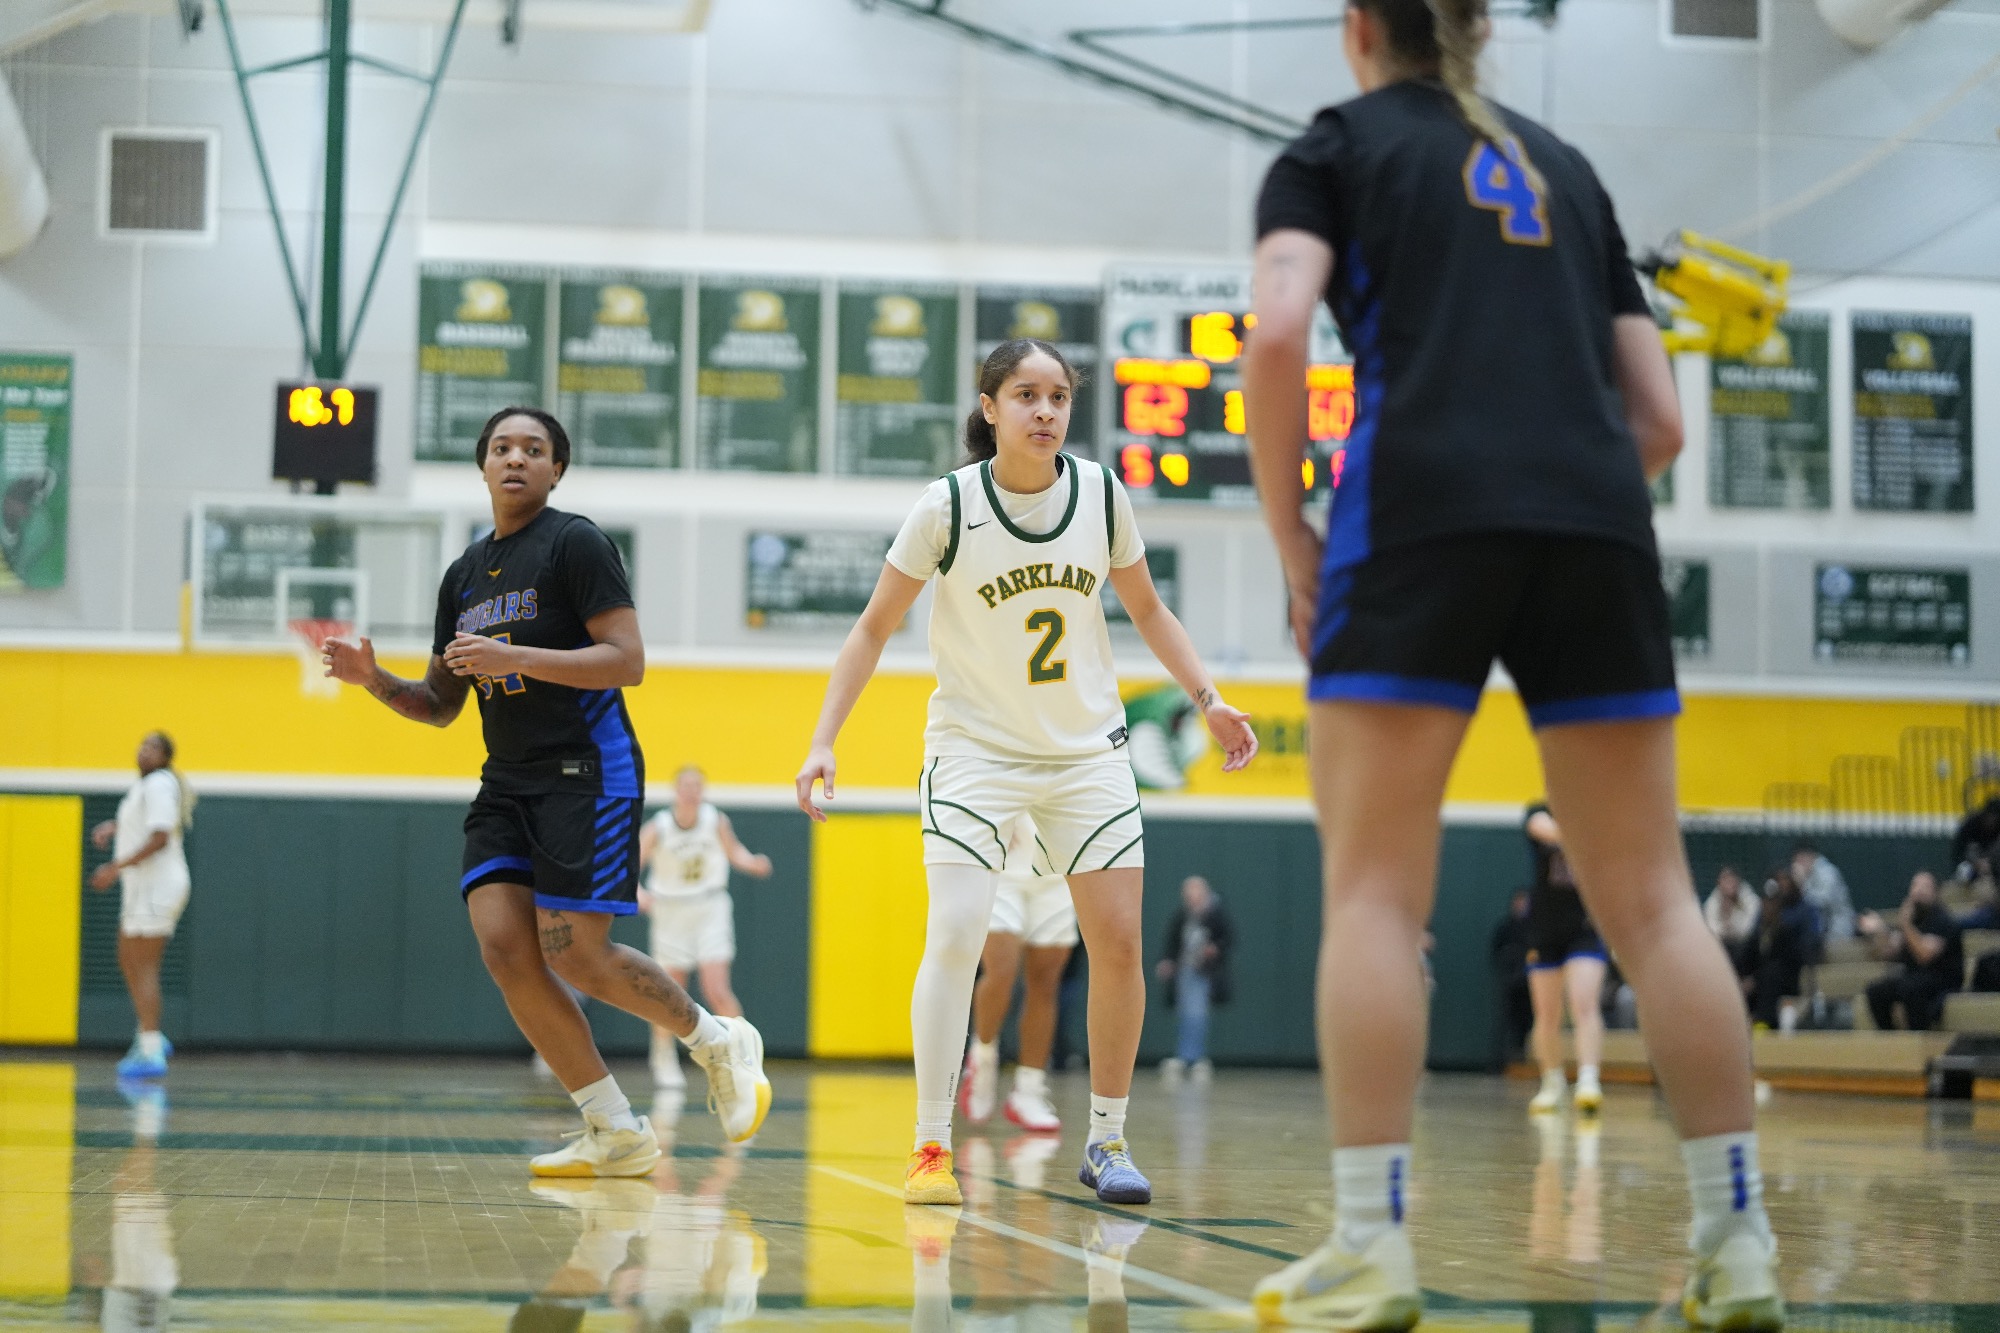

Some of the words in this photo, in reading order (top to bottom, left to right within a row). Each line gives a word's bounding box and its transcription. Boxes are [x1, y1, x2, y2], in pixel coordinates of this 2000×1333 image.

[1462, 138, 1552, 246] 4
[1124, 384, 1189, 436] 62
[1308, 388, 1354, 441] 60
[456, 588, 538, 634] COUGARS
[976, 563, 1096, 609] PARKLAND
[1024, 608, 1067, 685] 2
